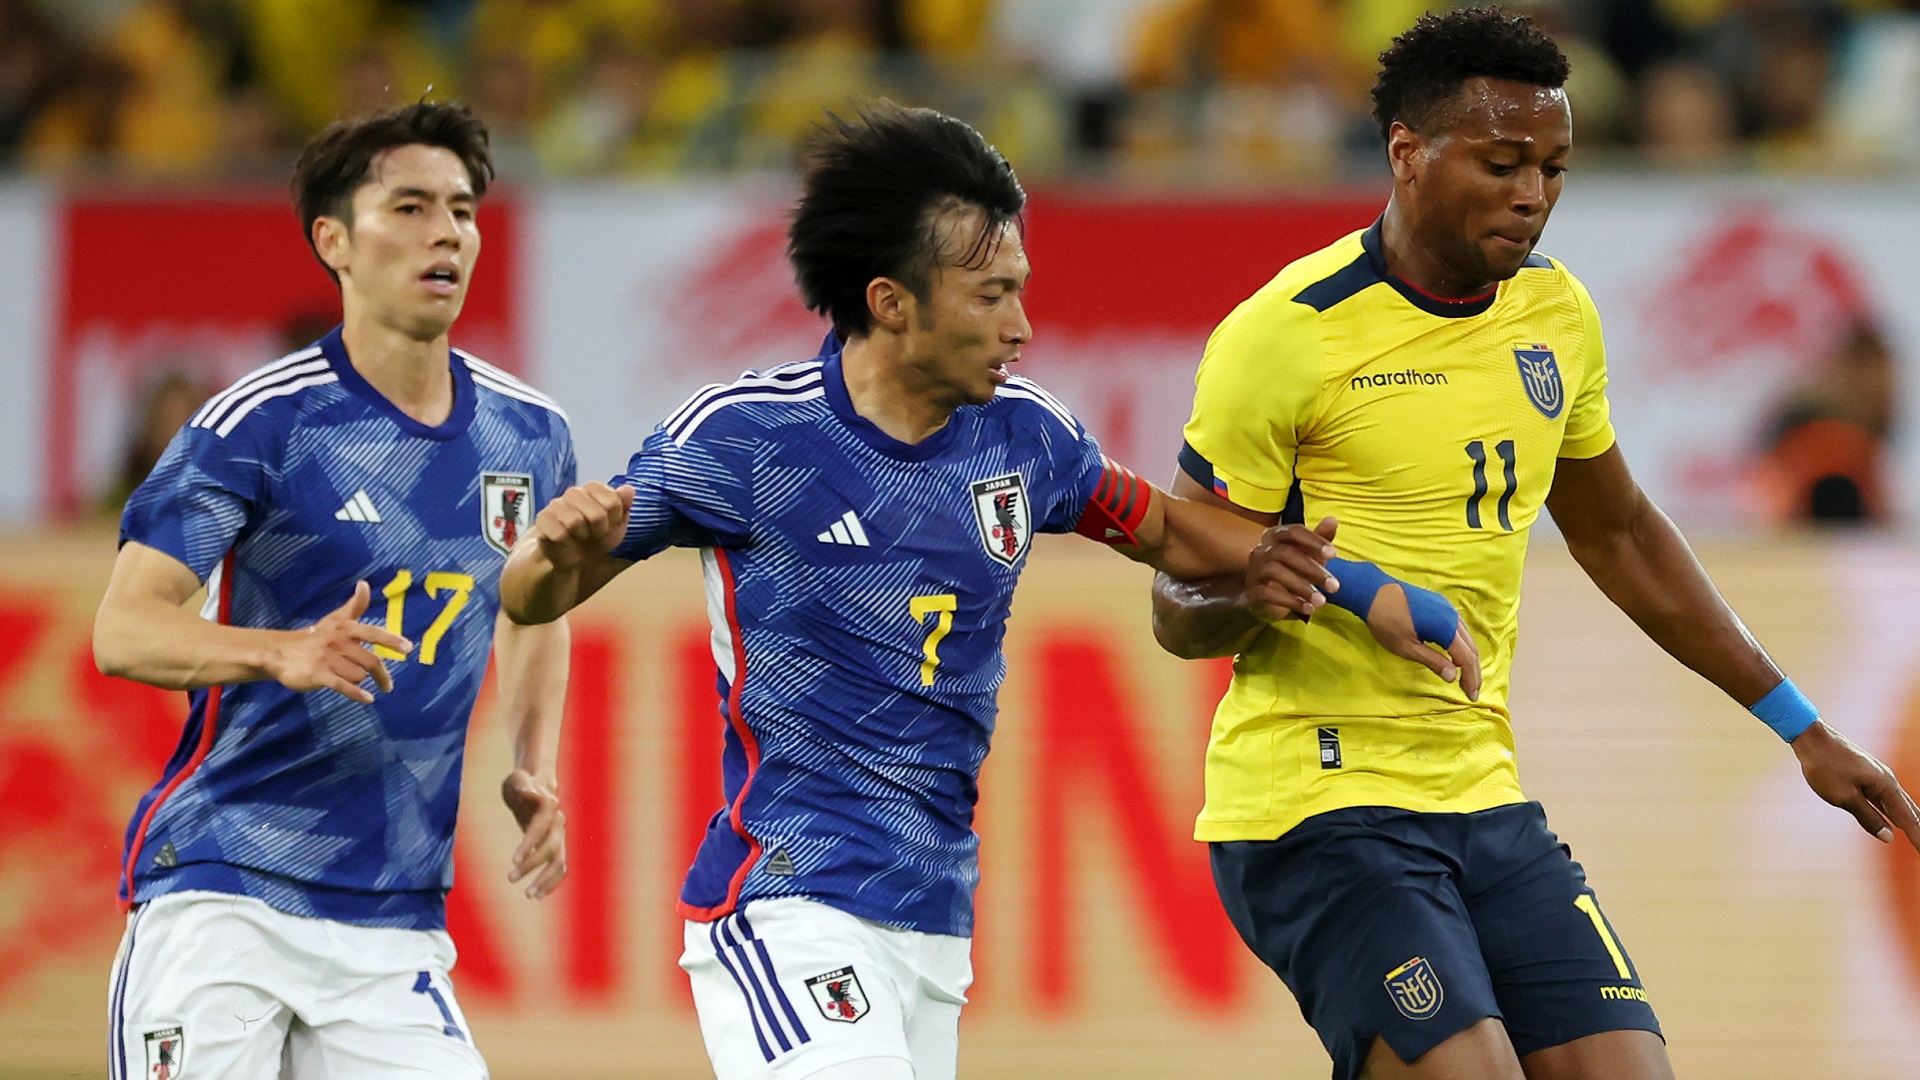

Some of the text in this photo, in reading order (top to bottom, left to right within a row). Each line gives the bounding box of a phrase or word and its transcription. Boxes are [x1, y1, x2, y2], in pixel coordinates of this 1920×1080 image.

[1351, 369, 1449, 390] marathon
[984, 479, 1012, 492] JAPAN
[1464, 440, 1518, 532] 11
[372, 568, 475, 666] 17
[909, 594, 957, 687] 7
[816, 969, 844, 983] JAPAN
